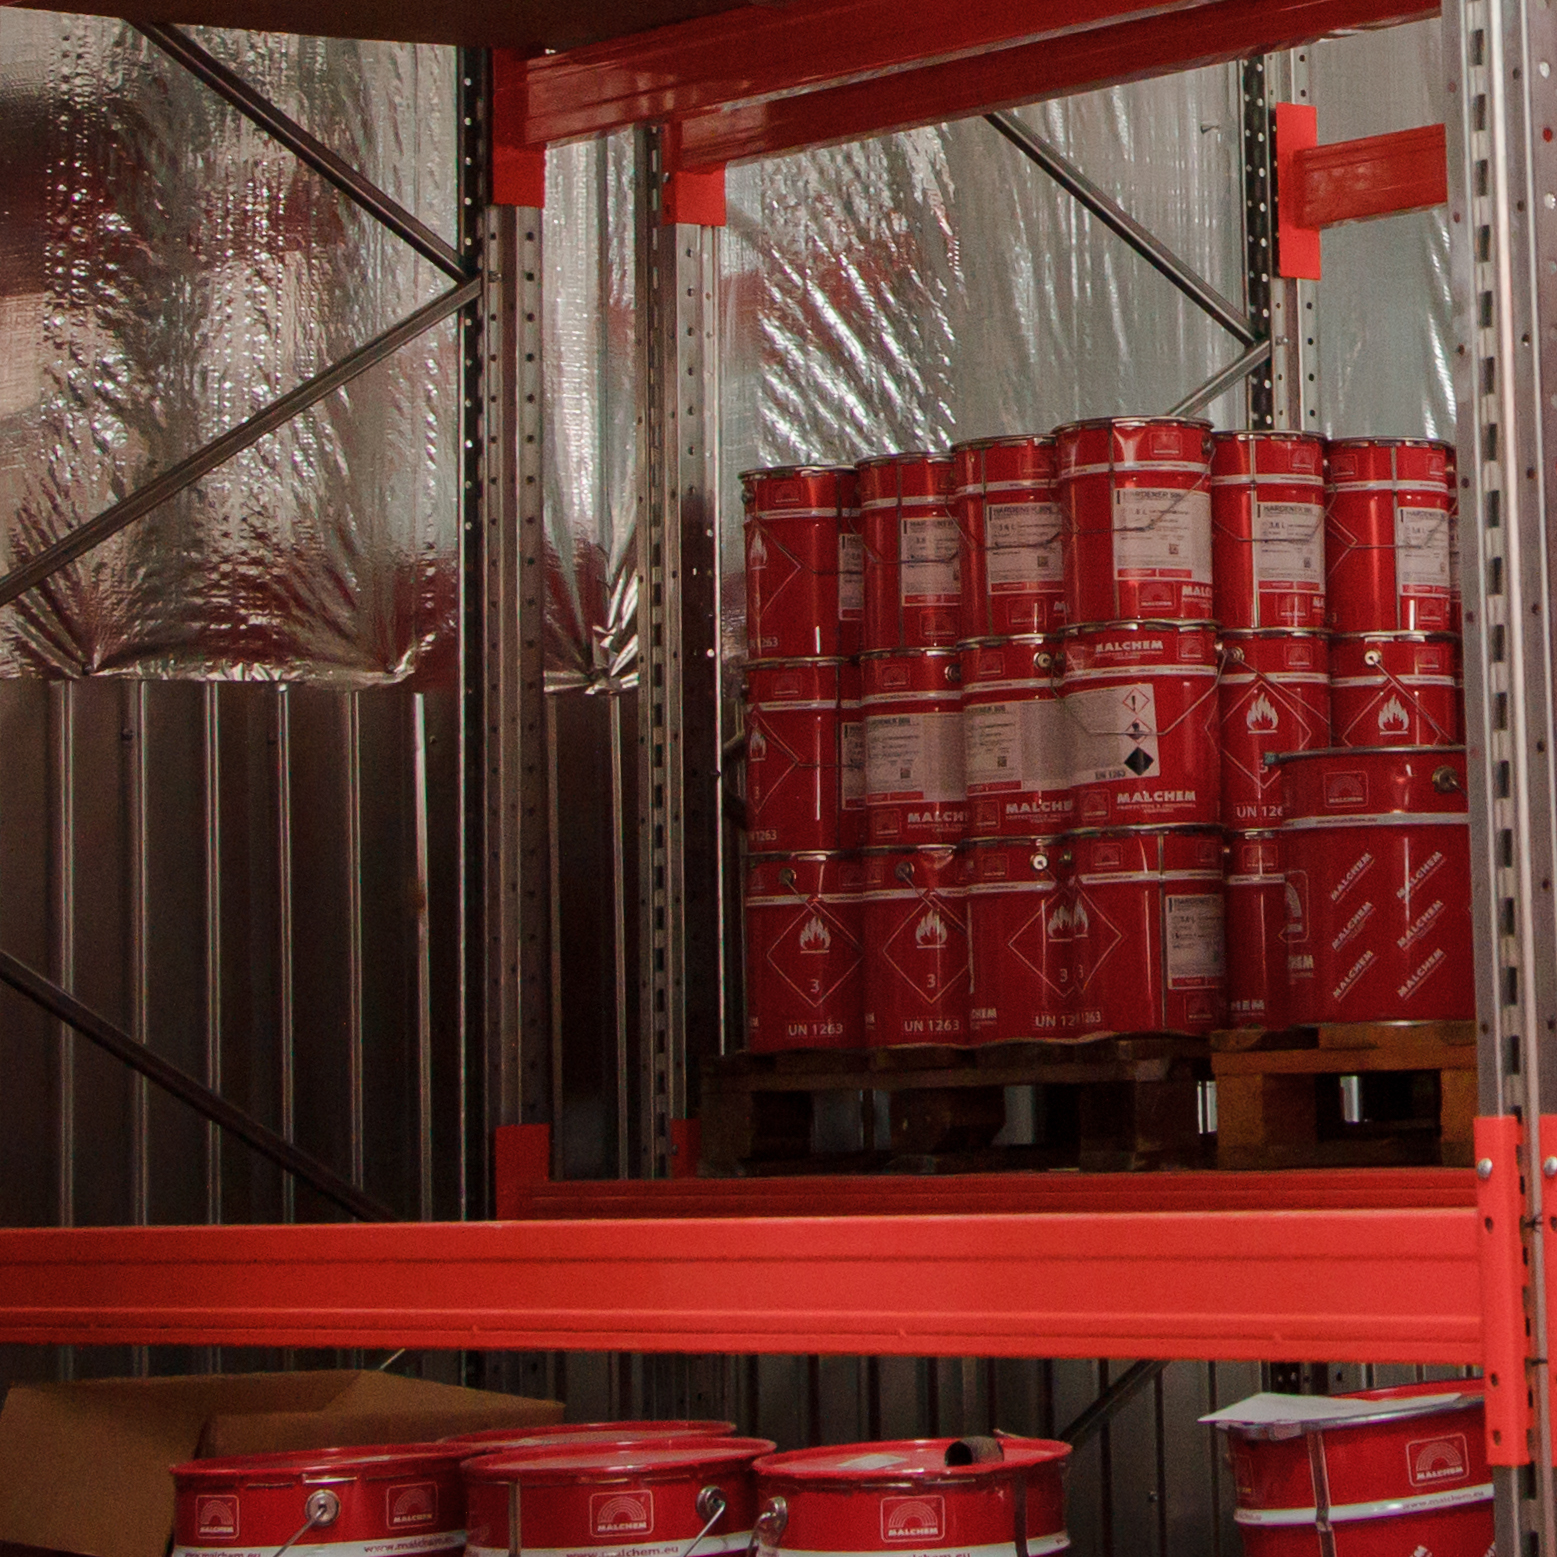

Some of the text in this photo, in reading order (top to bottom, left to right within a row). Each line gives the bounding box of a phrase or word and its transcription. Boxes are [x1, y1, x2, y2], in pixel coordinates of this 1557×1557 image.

[1117, 790, 1196, 804] MALCHEM
[1236, 805, 1258, 818] UN
[927, 974, 937, 989] 3
[1060, 968, 1068, 982] 3
[810, 979, 820, 993] 3
[904, 1019, 960, 1033] UN 1263
[1035, 1015, 1056, 1028] UN
[789, 1022, 844, 1036] UN 1263
[393, 1513, 435, 1524] MALCHEM
[597, 1521, 648, 1532] MALCHEM
[888, 1526, 938, 1537] MALCHEM
